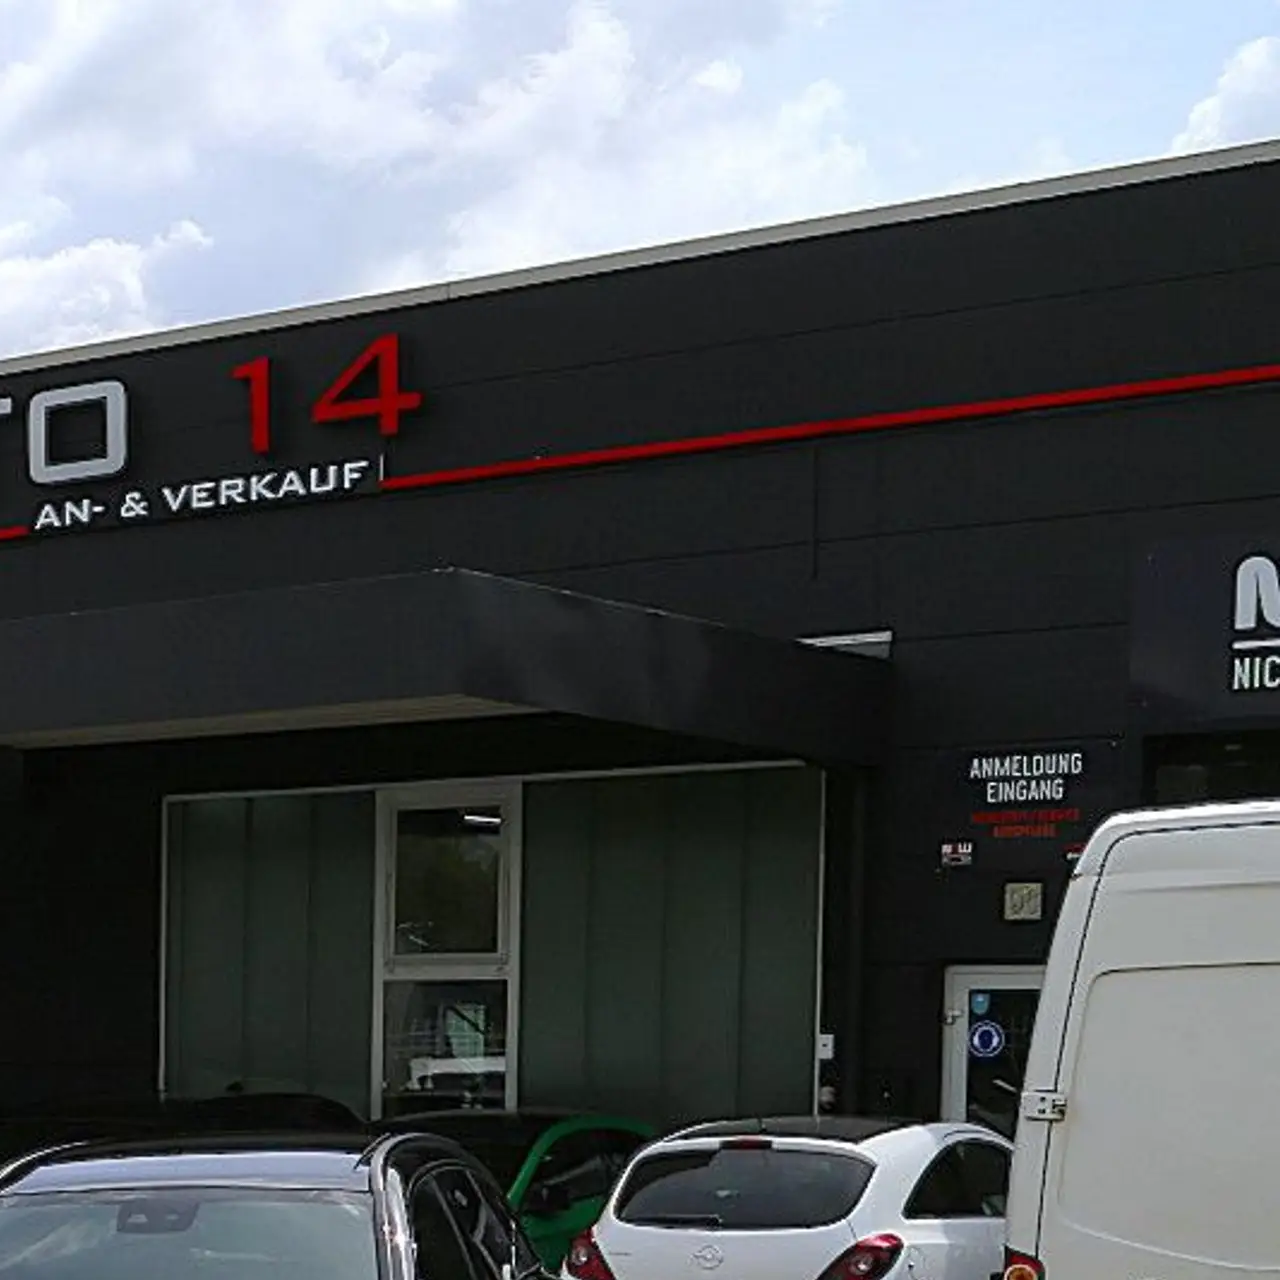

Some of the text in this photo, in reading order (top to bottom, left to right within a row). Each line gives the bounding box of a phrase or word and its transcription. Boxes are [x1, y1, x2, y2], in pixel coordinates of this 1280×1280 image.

[229, 331, 423, 456] 14
[34, 460, 369, 531] AN- & VERKAUF
[970, 752, 1083, 779] ANMELDUNG
[986, 777, 1064, 803] EINGANG
